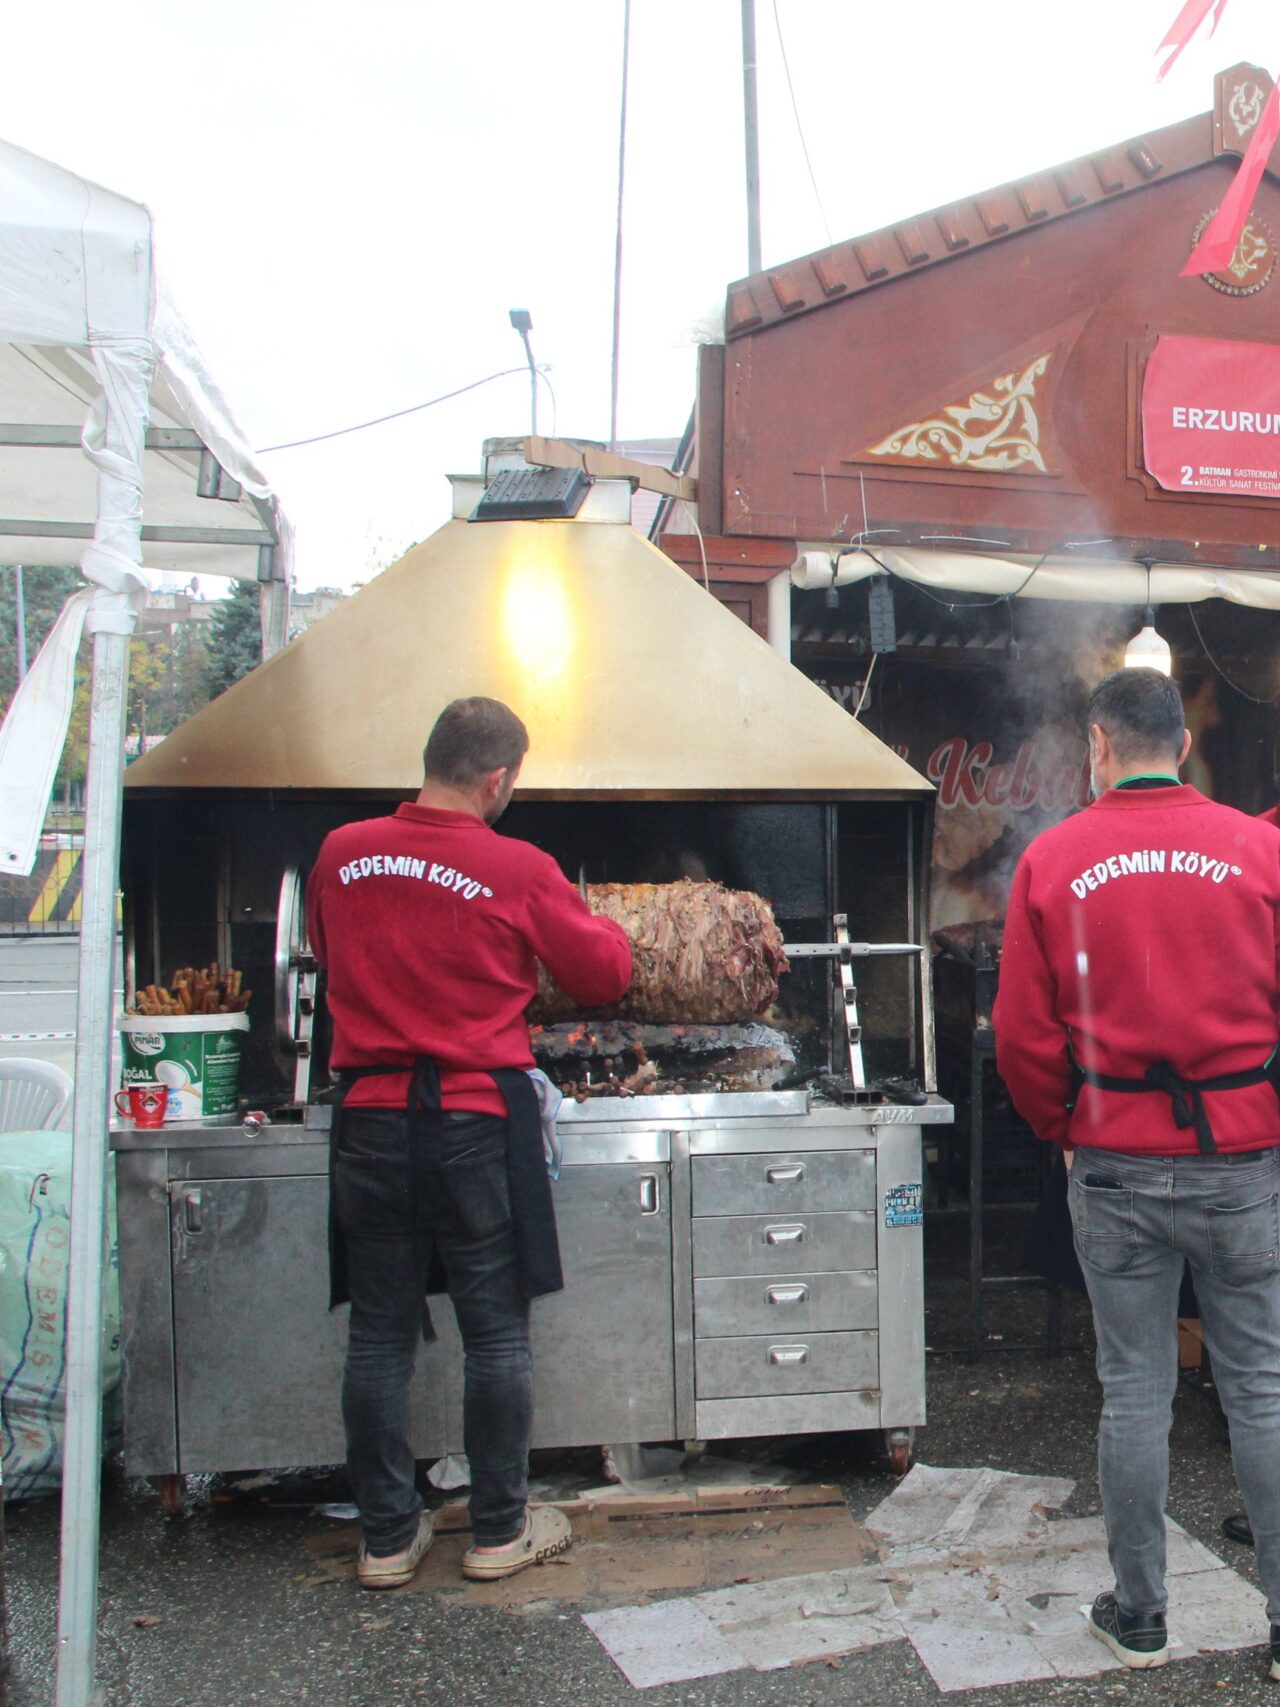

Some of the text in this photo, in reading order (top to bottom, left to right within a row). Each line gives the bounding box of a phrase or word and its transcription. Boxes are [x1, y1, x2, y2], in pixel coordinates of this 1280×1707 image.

[1180, 465, 1200, 486] 2.
[1199, 466, 1231, 476] BATMAN
[1233, 468, 1278, 480] GASTRONOMİ
[1199, 476, 1227, 488] KÜLTÜR
[1229, 478, 1252, 489] SANAT
[535, 1535, 570, 1561] crocs
